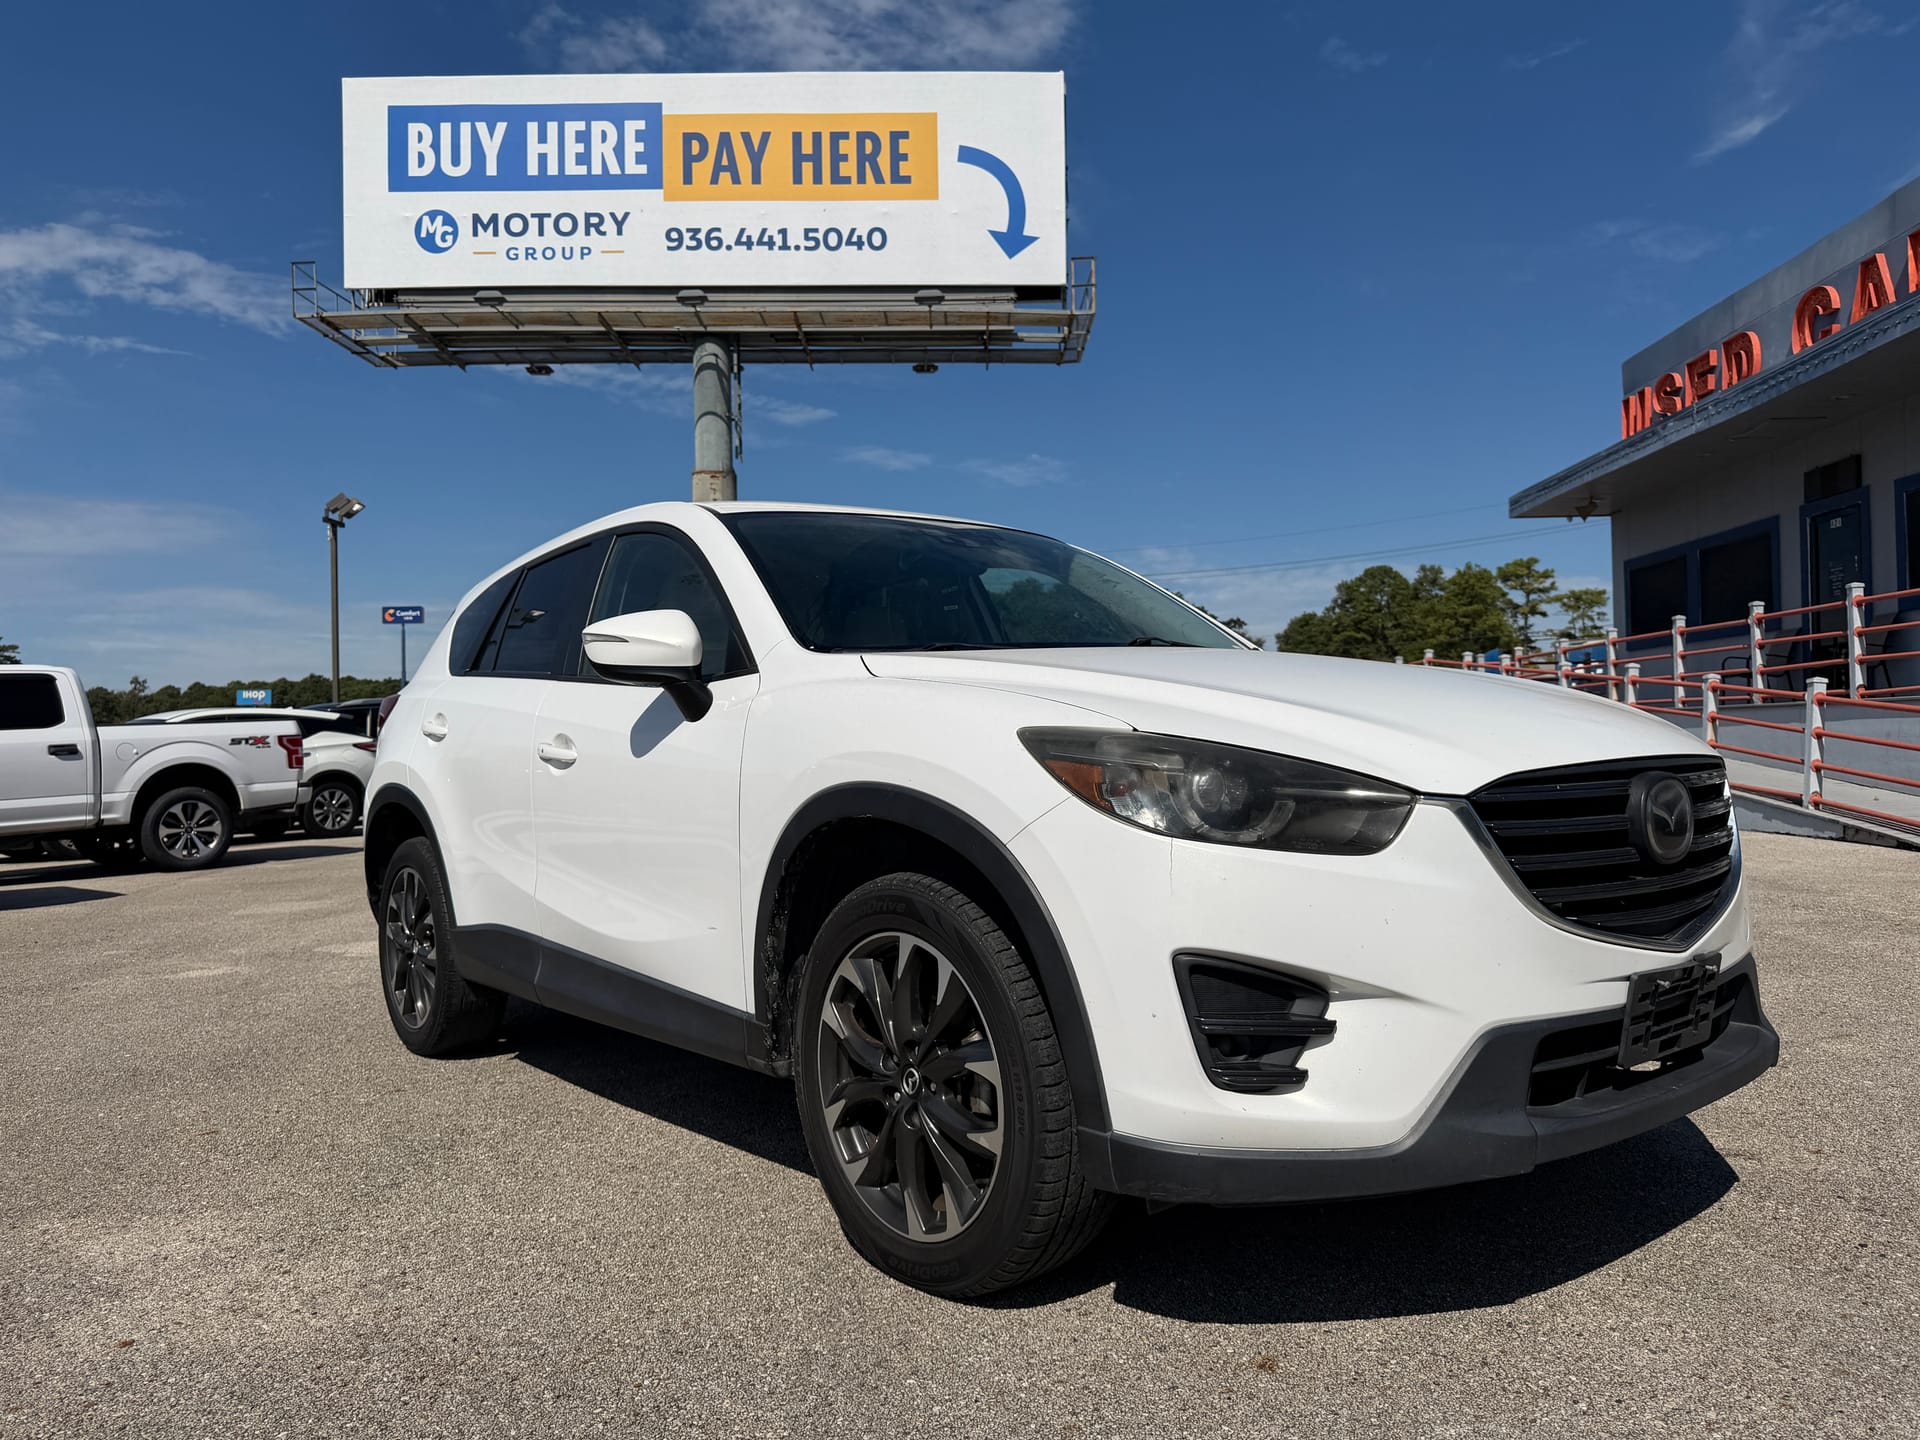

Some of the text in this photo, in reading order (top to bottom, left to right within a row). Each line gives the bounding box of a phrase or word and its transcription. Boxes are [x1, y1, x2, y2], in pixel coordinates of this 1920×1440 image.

[407, 119, 648, 177] BUY HERE
[681, 130, 912, 186] PAY HERE
[420, 215, 454, 248] MG
[471, 211, 631, 238] MOTORY
[664, 226, 888, 252] 936.441.5040
[505, 246, 592, 261] GROUP
[1622, 331, 1762, 440] USED
[229, 736, 271, 746] STX
